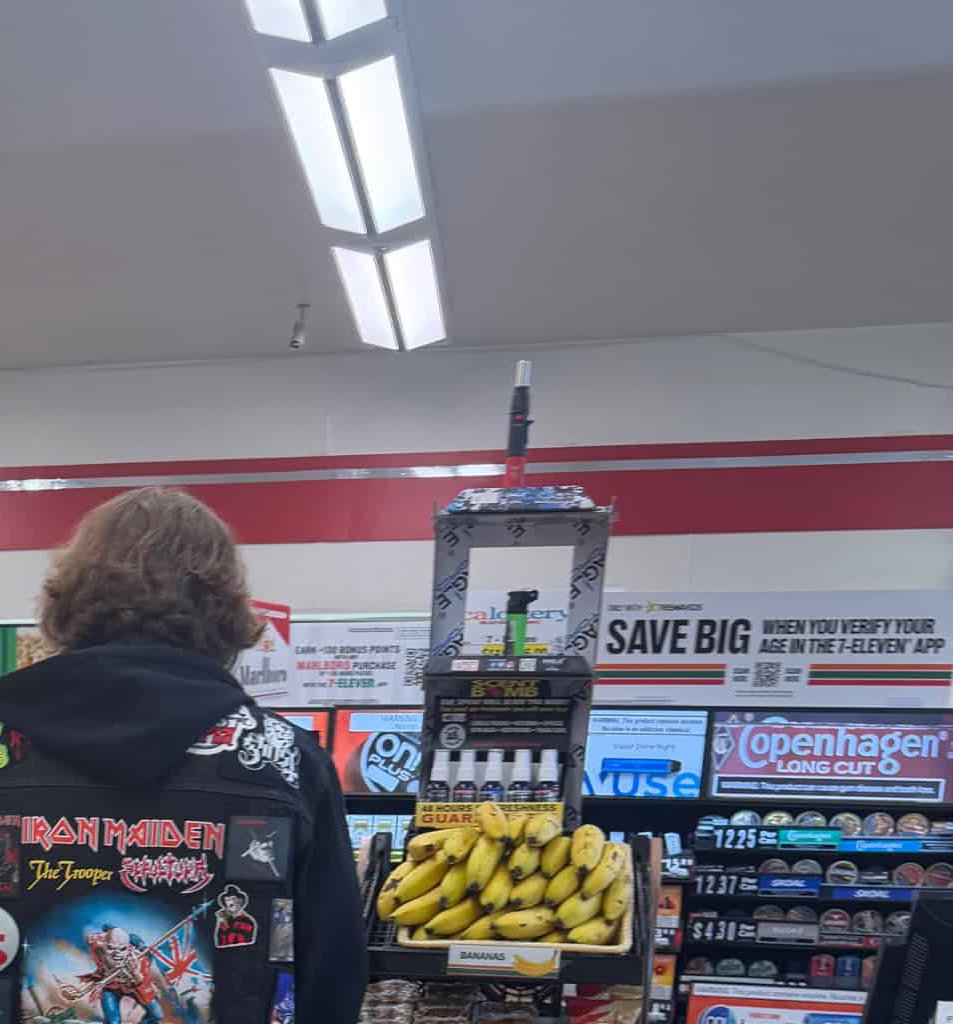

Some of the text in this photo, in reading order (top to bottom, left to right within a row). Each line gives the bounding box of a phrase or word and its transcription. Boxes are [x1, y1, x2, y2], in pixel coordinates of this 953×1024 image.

[606, 618, 752, 655] SAVE BIG
[762, 618, 936, 635] WHEN YOU VERIFY YOUR
[758, 638, 788, 654] AGE
[789, 638, 806, 654] IN
[808, 638, 836, 654] THE
[912, 638, 946, 654] APP
[739, 716, 941, 775] Copenhagen
[369, 753, 414, 782] PLUS
[776, 760, 876, 775] LONG CUT
[21, 815, 226, 860] IRON MAIDEN
[27, 860, 114, 891] The Trooper
[460, 951, 506, 961] BANANAS
